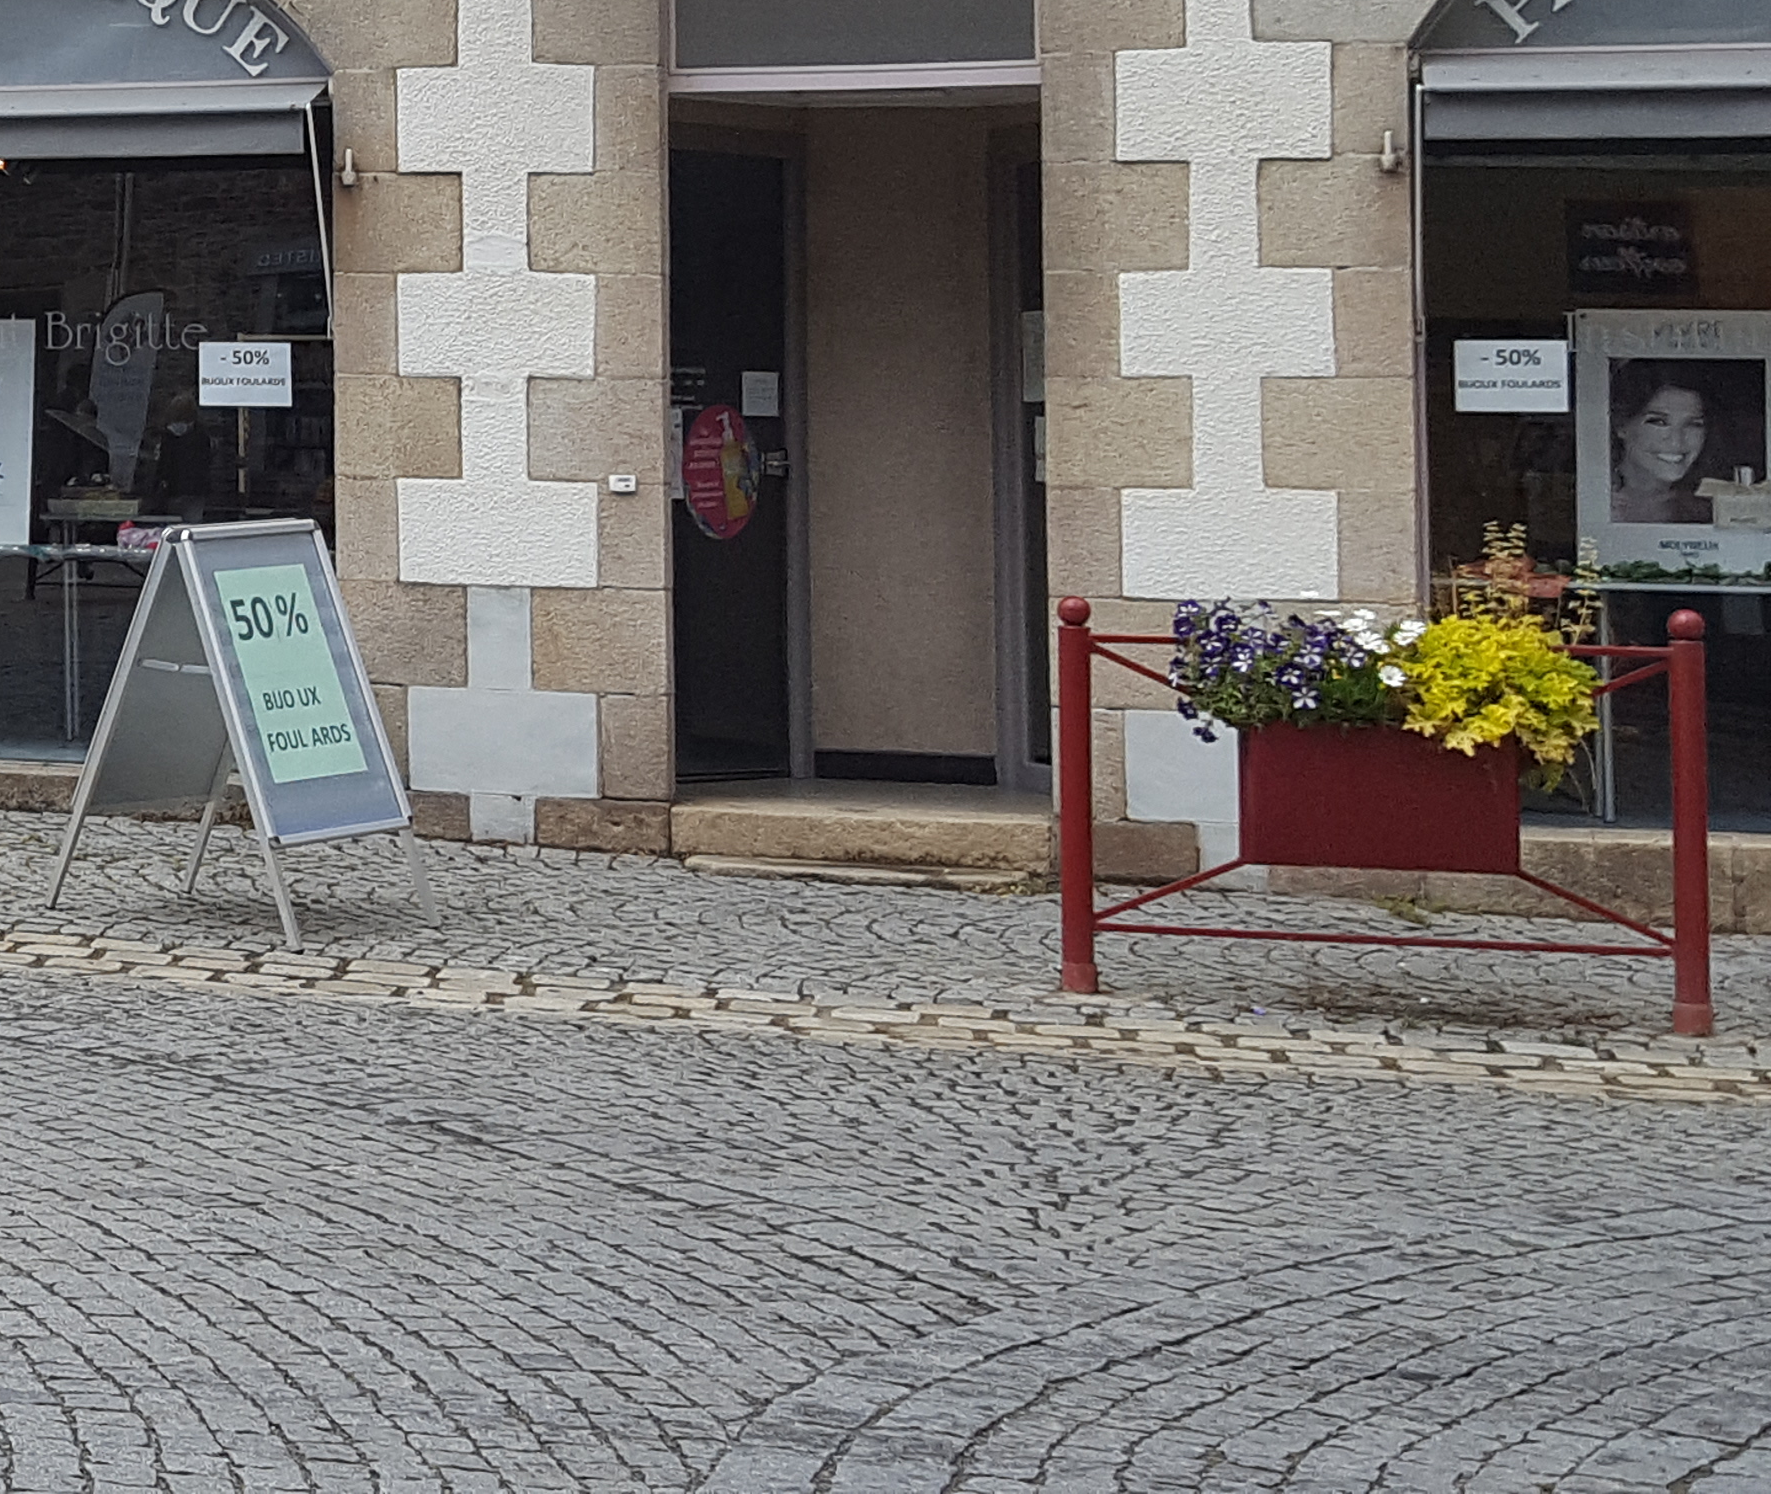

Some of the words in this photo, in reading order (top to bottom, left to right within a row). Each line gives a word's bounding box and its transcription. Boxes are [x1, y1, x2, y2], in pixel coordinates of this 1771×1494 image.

[44, 310, 209, 366] Brigitte
[231, 350, 271, 366] 50%
[1495, 348, 1542, 366] 50%
[229, 592, 309, 642] 50%
